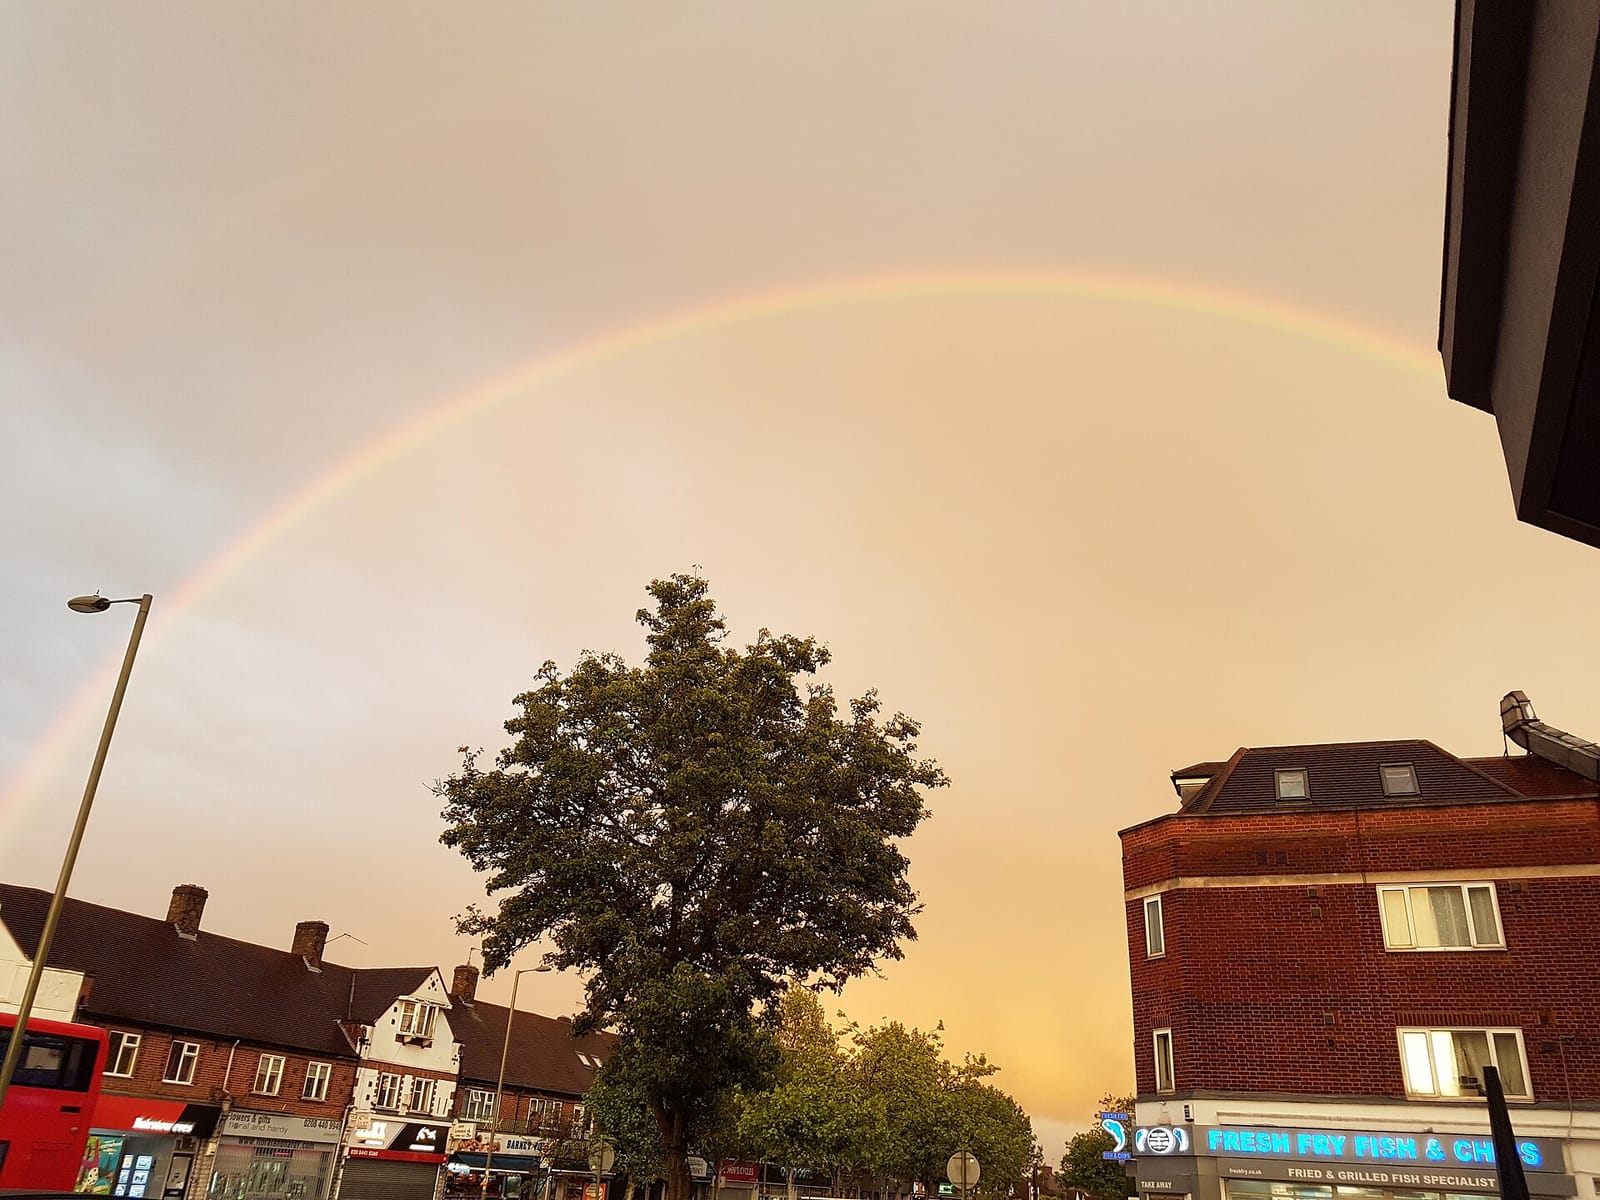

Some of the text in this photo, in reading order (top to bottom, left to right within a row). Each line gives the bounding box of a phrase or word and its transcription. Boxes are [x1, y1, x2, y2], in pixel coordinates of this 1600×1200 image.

[1208, 1129, 1542, 1167] FRESH FRY FISH & CHS
[1141, 1181, 1172, 1189] TAKE AWAY
[1288, 1168, 1497, 1187] FRIED & GRILLED FISH SPECIALIST
